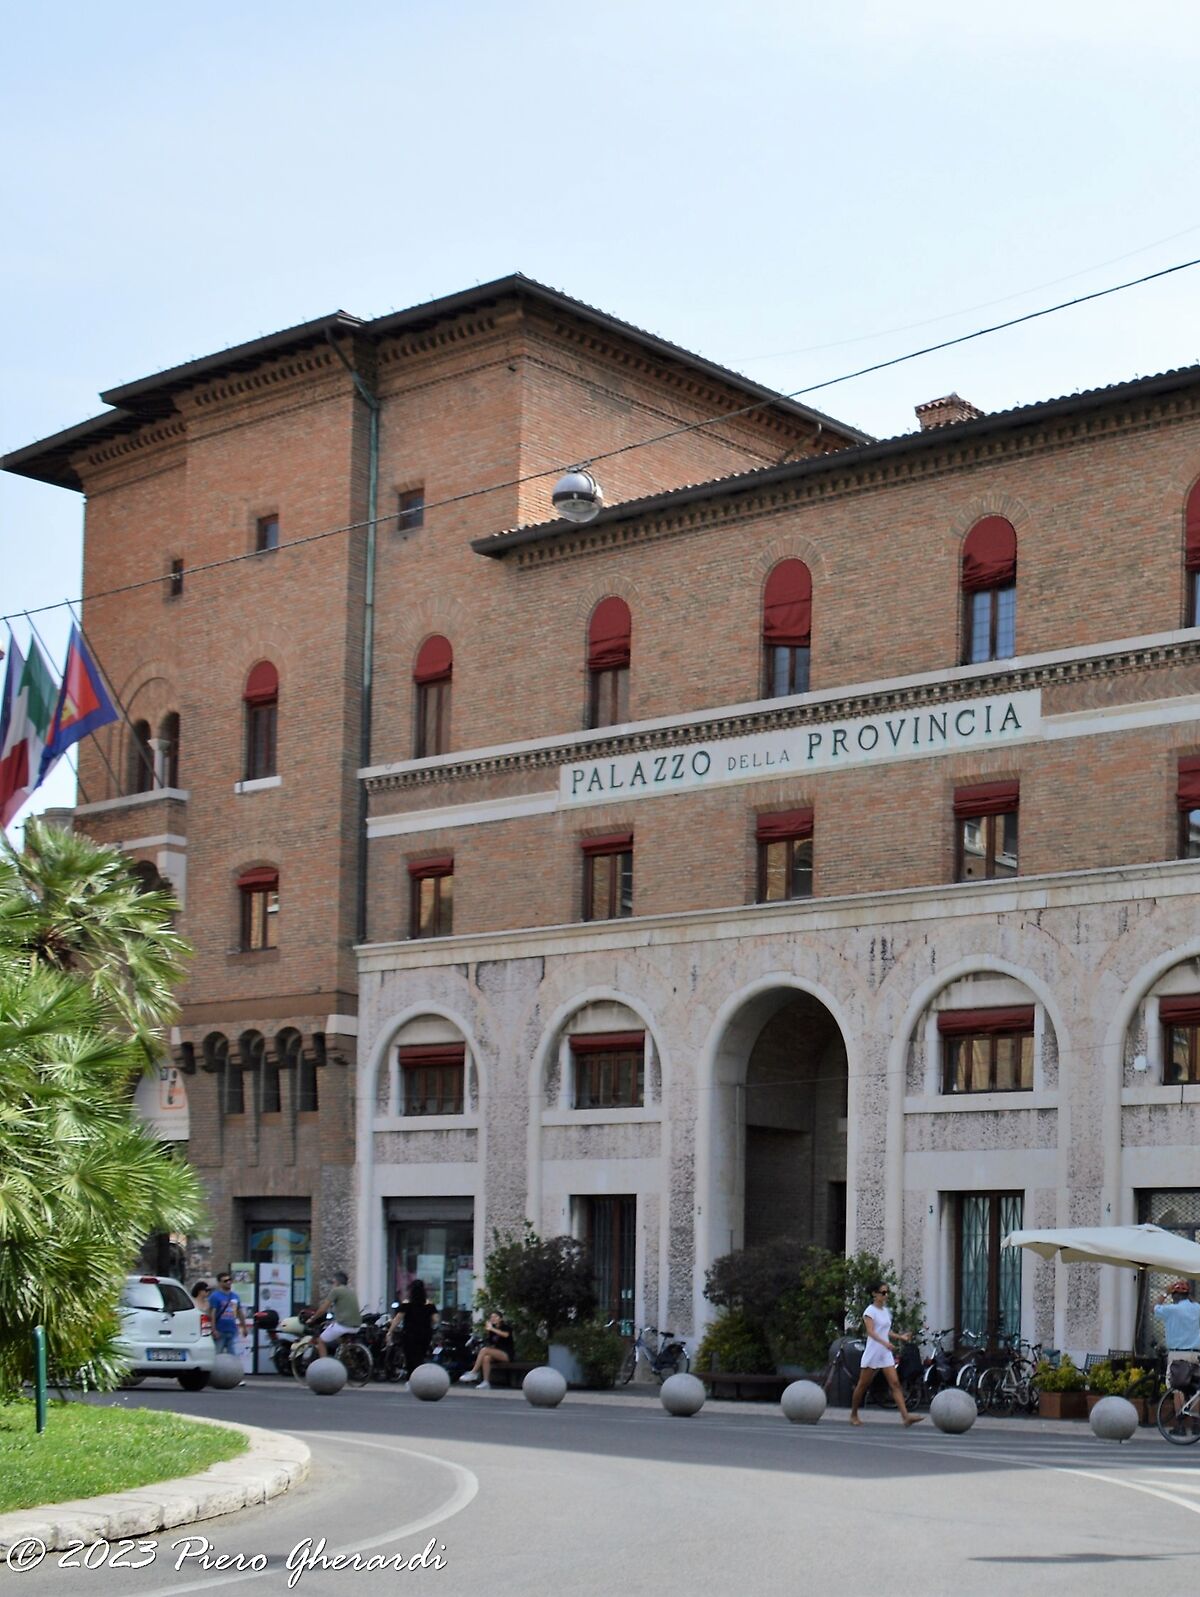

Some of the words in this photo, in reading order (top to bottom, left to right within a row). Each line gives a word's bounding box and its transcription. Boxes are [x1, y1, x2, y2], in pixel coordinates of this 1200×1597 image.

[572, 750, 711, 794] PALAZZO
[728, 749, 790, 771] DELLA
[807, 702, 1022, 760] PROVINCIA
